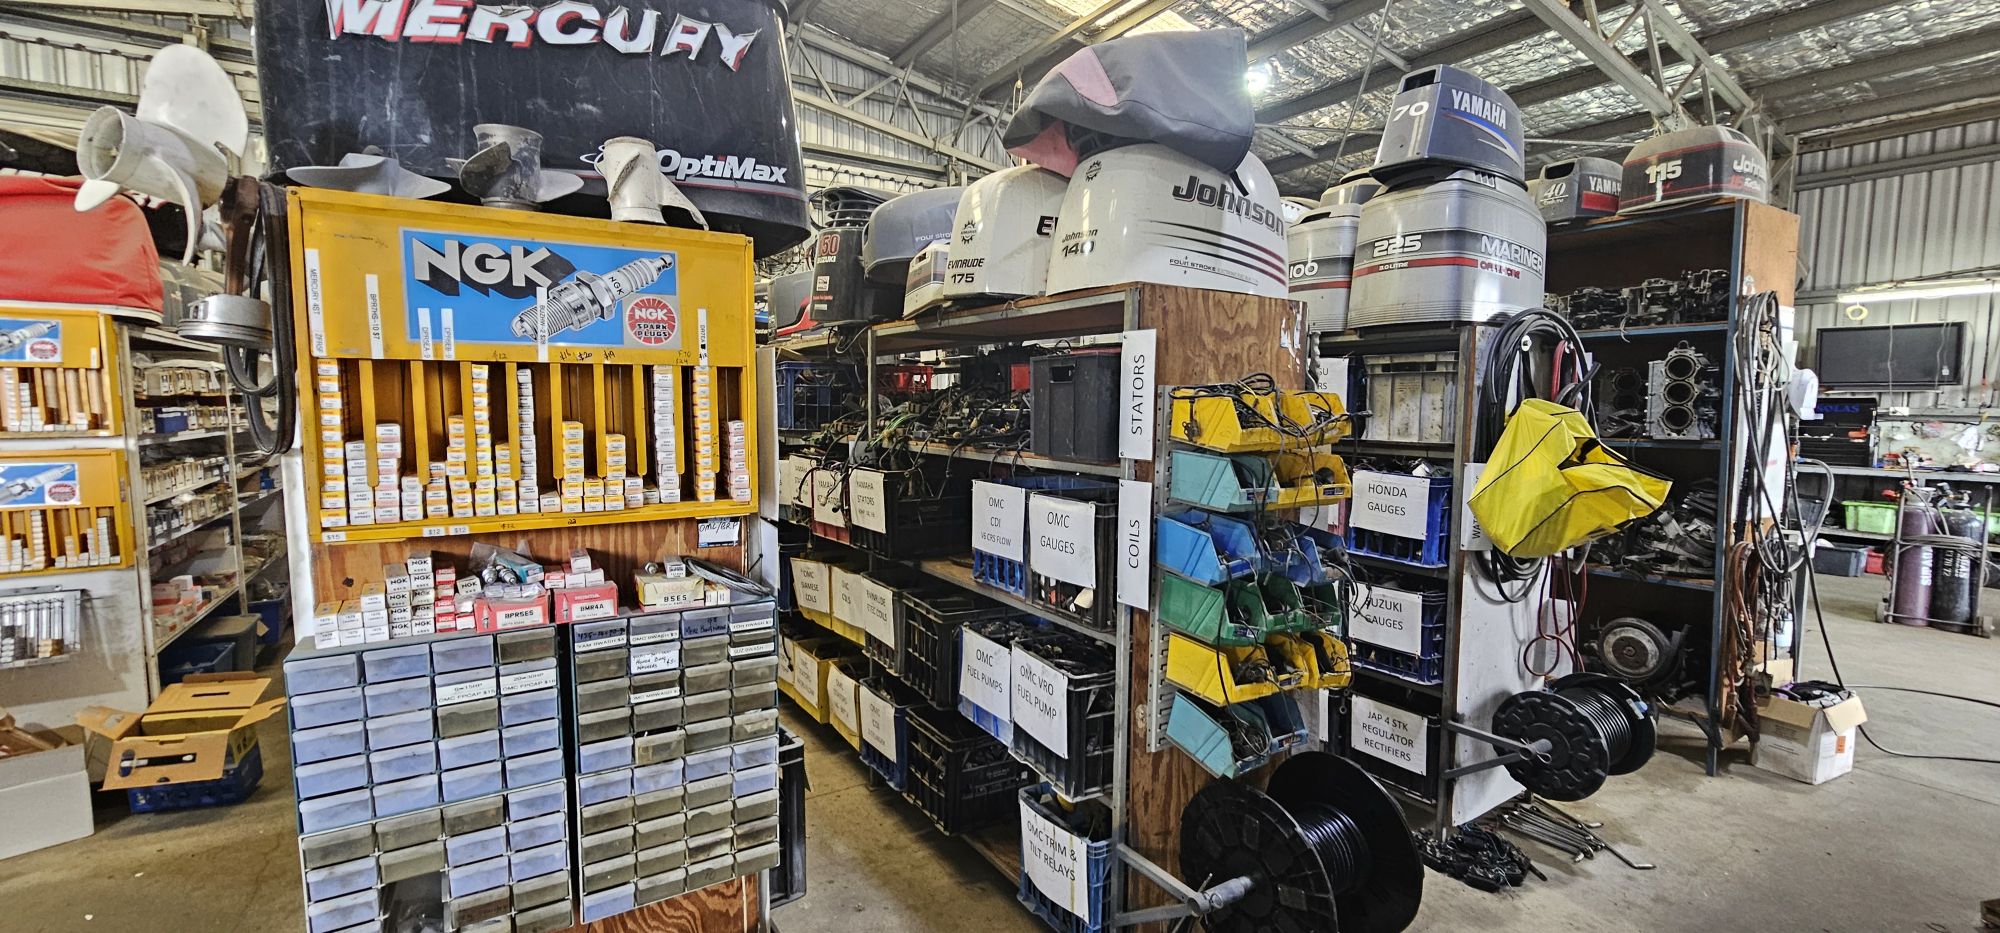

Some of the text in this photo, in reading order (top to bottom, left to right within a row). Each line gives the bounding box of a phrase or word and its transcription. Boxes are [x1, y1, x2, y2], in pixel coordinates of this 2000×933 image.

[325, 0, 762, 72] MERCURY
[1392, 101, 1430, 122] 70
[1451, 88, 1507, 130] YAMAHA
[655, 149, 788, 184] OptiMax
[1645, 160, 1682, 184] 115
[1543, 182, 1567, 199] 40
[1172, 175, 1285, 240] Johnson
[1062, 229, 1098, 243] Johnson
[1373, 235, 1422, 257] 225
[1062, 241, 1095, 257] 140
[1481, 235, 1544, 272] MARINER
[412, 237, 551, 289] NGK
[947, 258, 985, 270] EVINRUDE
[1289, 262, 1319, 279] 100
[310, 269, 319, 301] MERCURY
[608, 276, 625, 295] NGK
[951, 273, 975, 284] 175
[369, 294, 379, 331] BPR7HS-10
[634, 308, 669, 321] NGK
[637, 322, 668, 330] SPARK
[637, 330, 669, 338] PLUGS
[1131, 353, 1146, 436] STATORS
[1367, 483, 1408, 499] HONDA
[988, 496, 1005, 510] OMC
[1367, 501, 1406, 517] GAUGES
[990, 516, 1002, 528] CDI
[1047, 511, 1071, 528] OMC
[980, 532, 988, 540] V6
[996, 536, 1012, 548] FLOW
[1040, 535, 1075, 555] GAUGES
[1128, 519, 1141, 570] COILS
[461, 581, 478, 589] NGK
[391, 622, 409, 630] NGK
[976, 648, 994, 668] OMC
[967, 666, 1004, 694] FUEL PUMPS
[1019, 664, 1054, 697] OMC VRO
[439, 695, 456, 703] OMC
[1017, 683, 1057, 720] FUEL PUMP
[1368, 711, 1409, 732] JAP 4 STK
[1362, 722, 1415, 749] REGULATOR
[1364, 737, 1412, 763] RECTIFIERS
[1026, 820, 1078, 862] OMC TRIM &
[1029, 839, 1076, 882] TILT RELAYS
